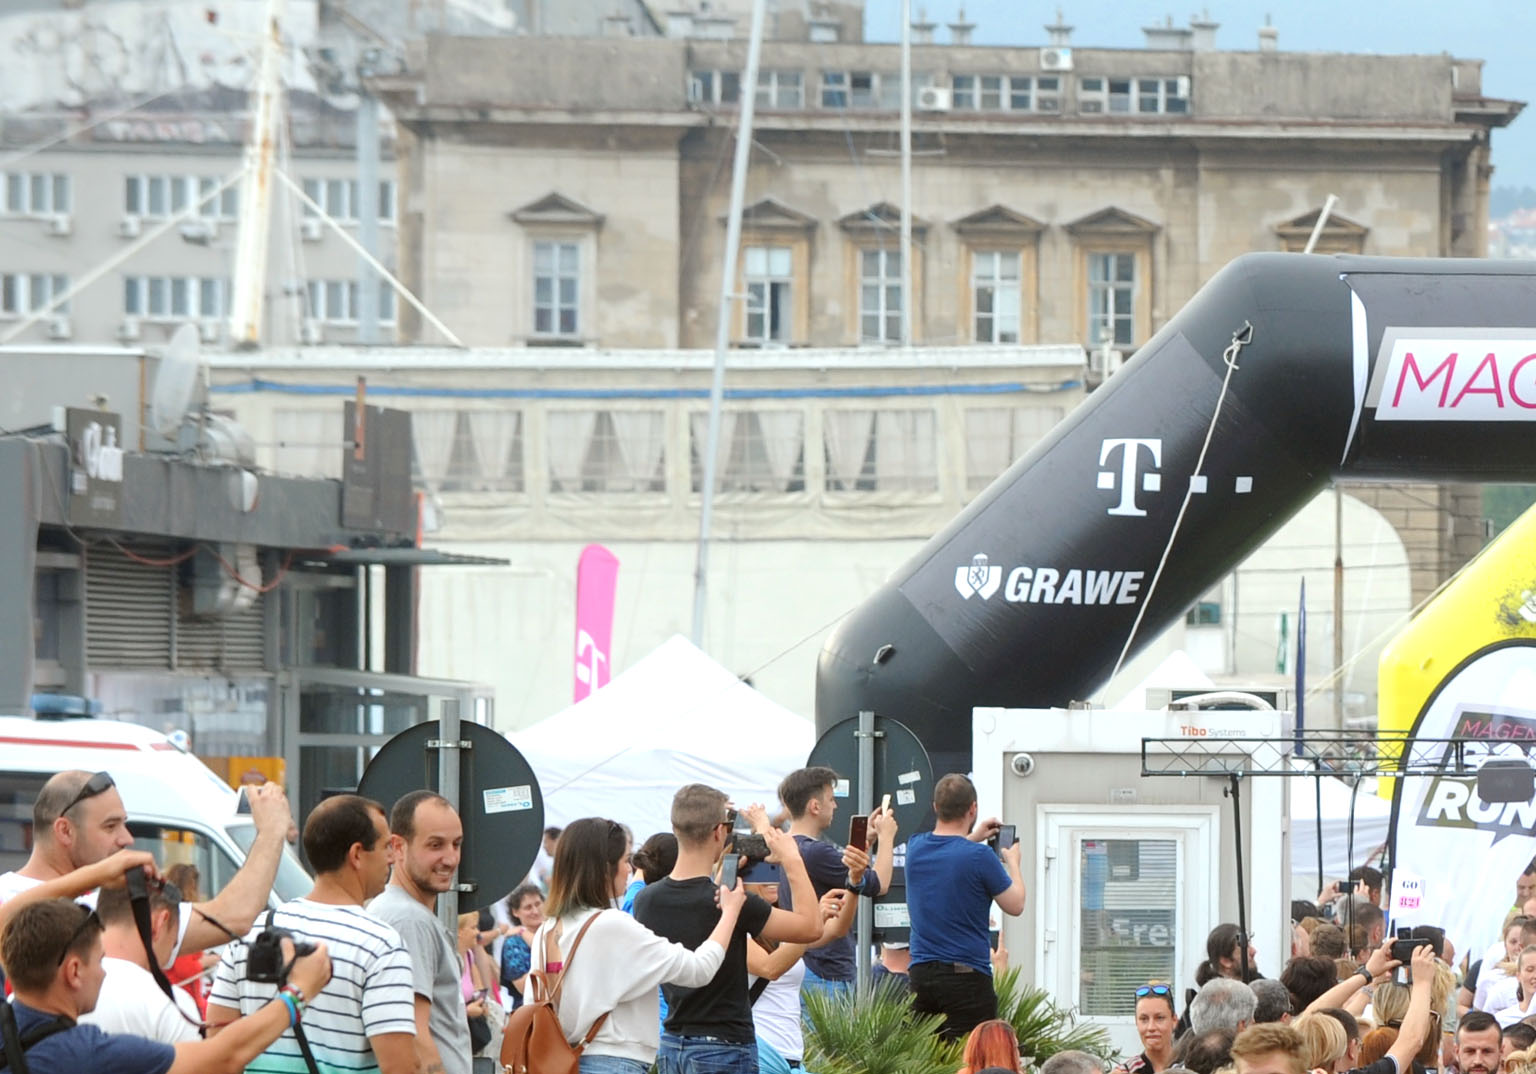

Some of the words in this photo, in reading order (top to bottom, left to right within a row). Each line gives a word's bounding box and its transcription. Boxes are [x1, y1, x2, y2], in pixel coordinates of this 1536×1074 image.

[1005, 566, 1145, 605] GRAWE
[1180, 725, 1207, 737] Tibo
[1208, 728, 1247, 738] Systems
